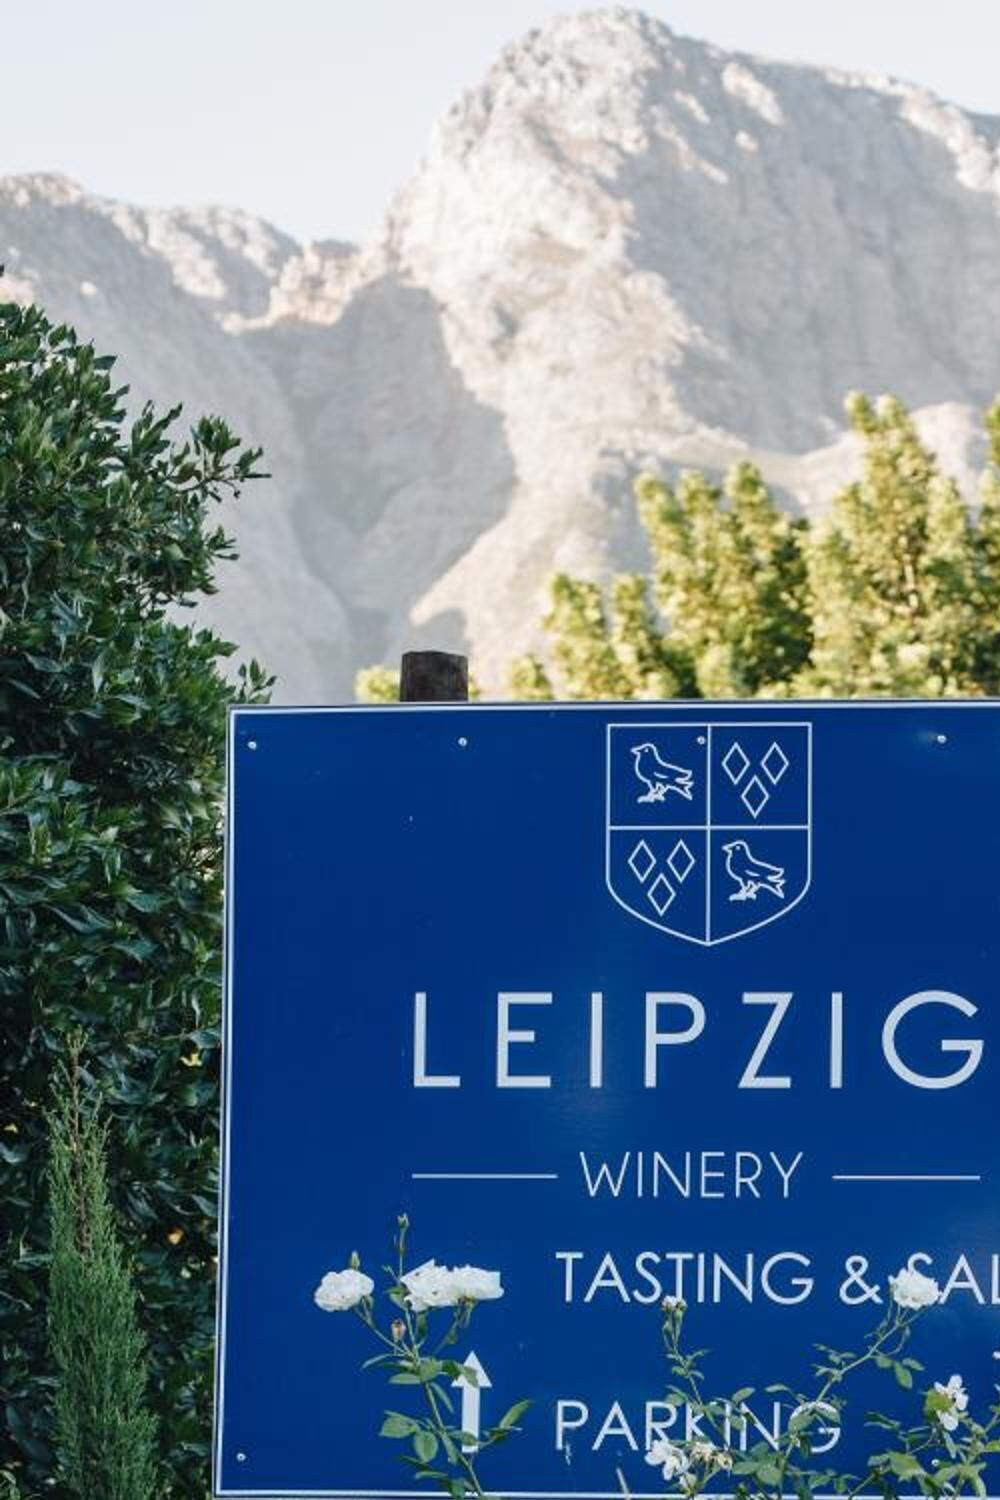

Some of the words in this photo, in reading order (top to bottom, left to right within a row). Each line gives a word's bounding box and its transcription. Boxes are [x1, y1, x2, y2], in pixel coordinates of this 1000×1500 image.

[413, 990, 984, 1089] LEIPZIG
[579, 1151, 804, 1199] WINERY
[555, 1252, 813, 1305] TASTING
[838, 1254, 883, 1305] &
[554, 1401, 842, 1454] PARKING
